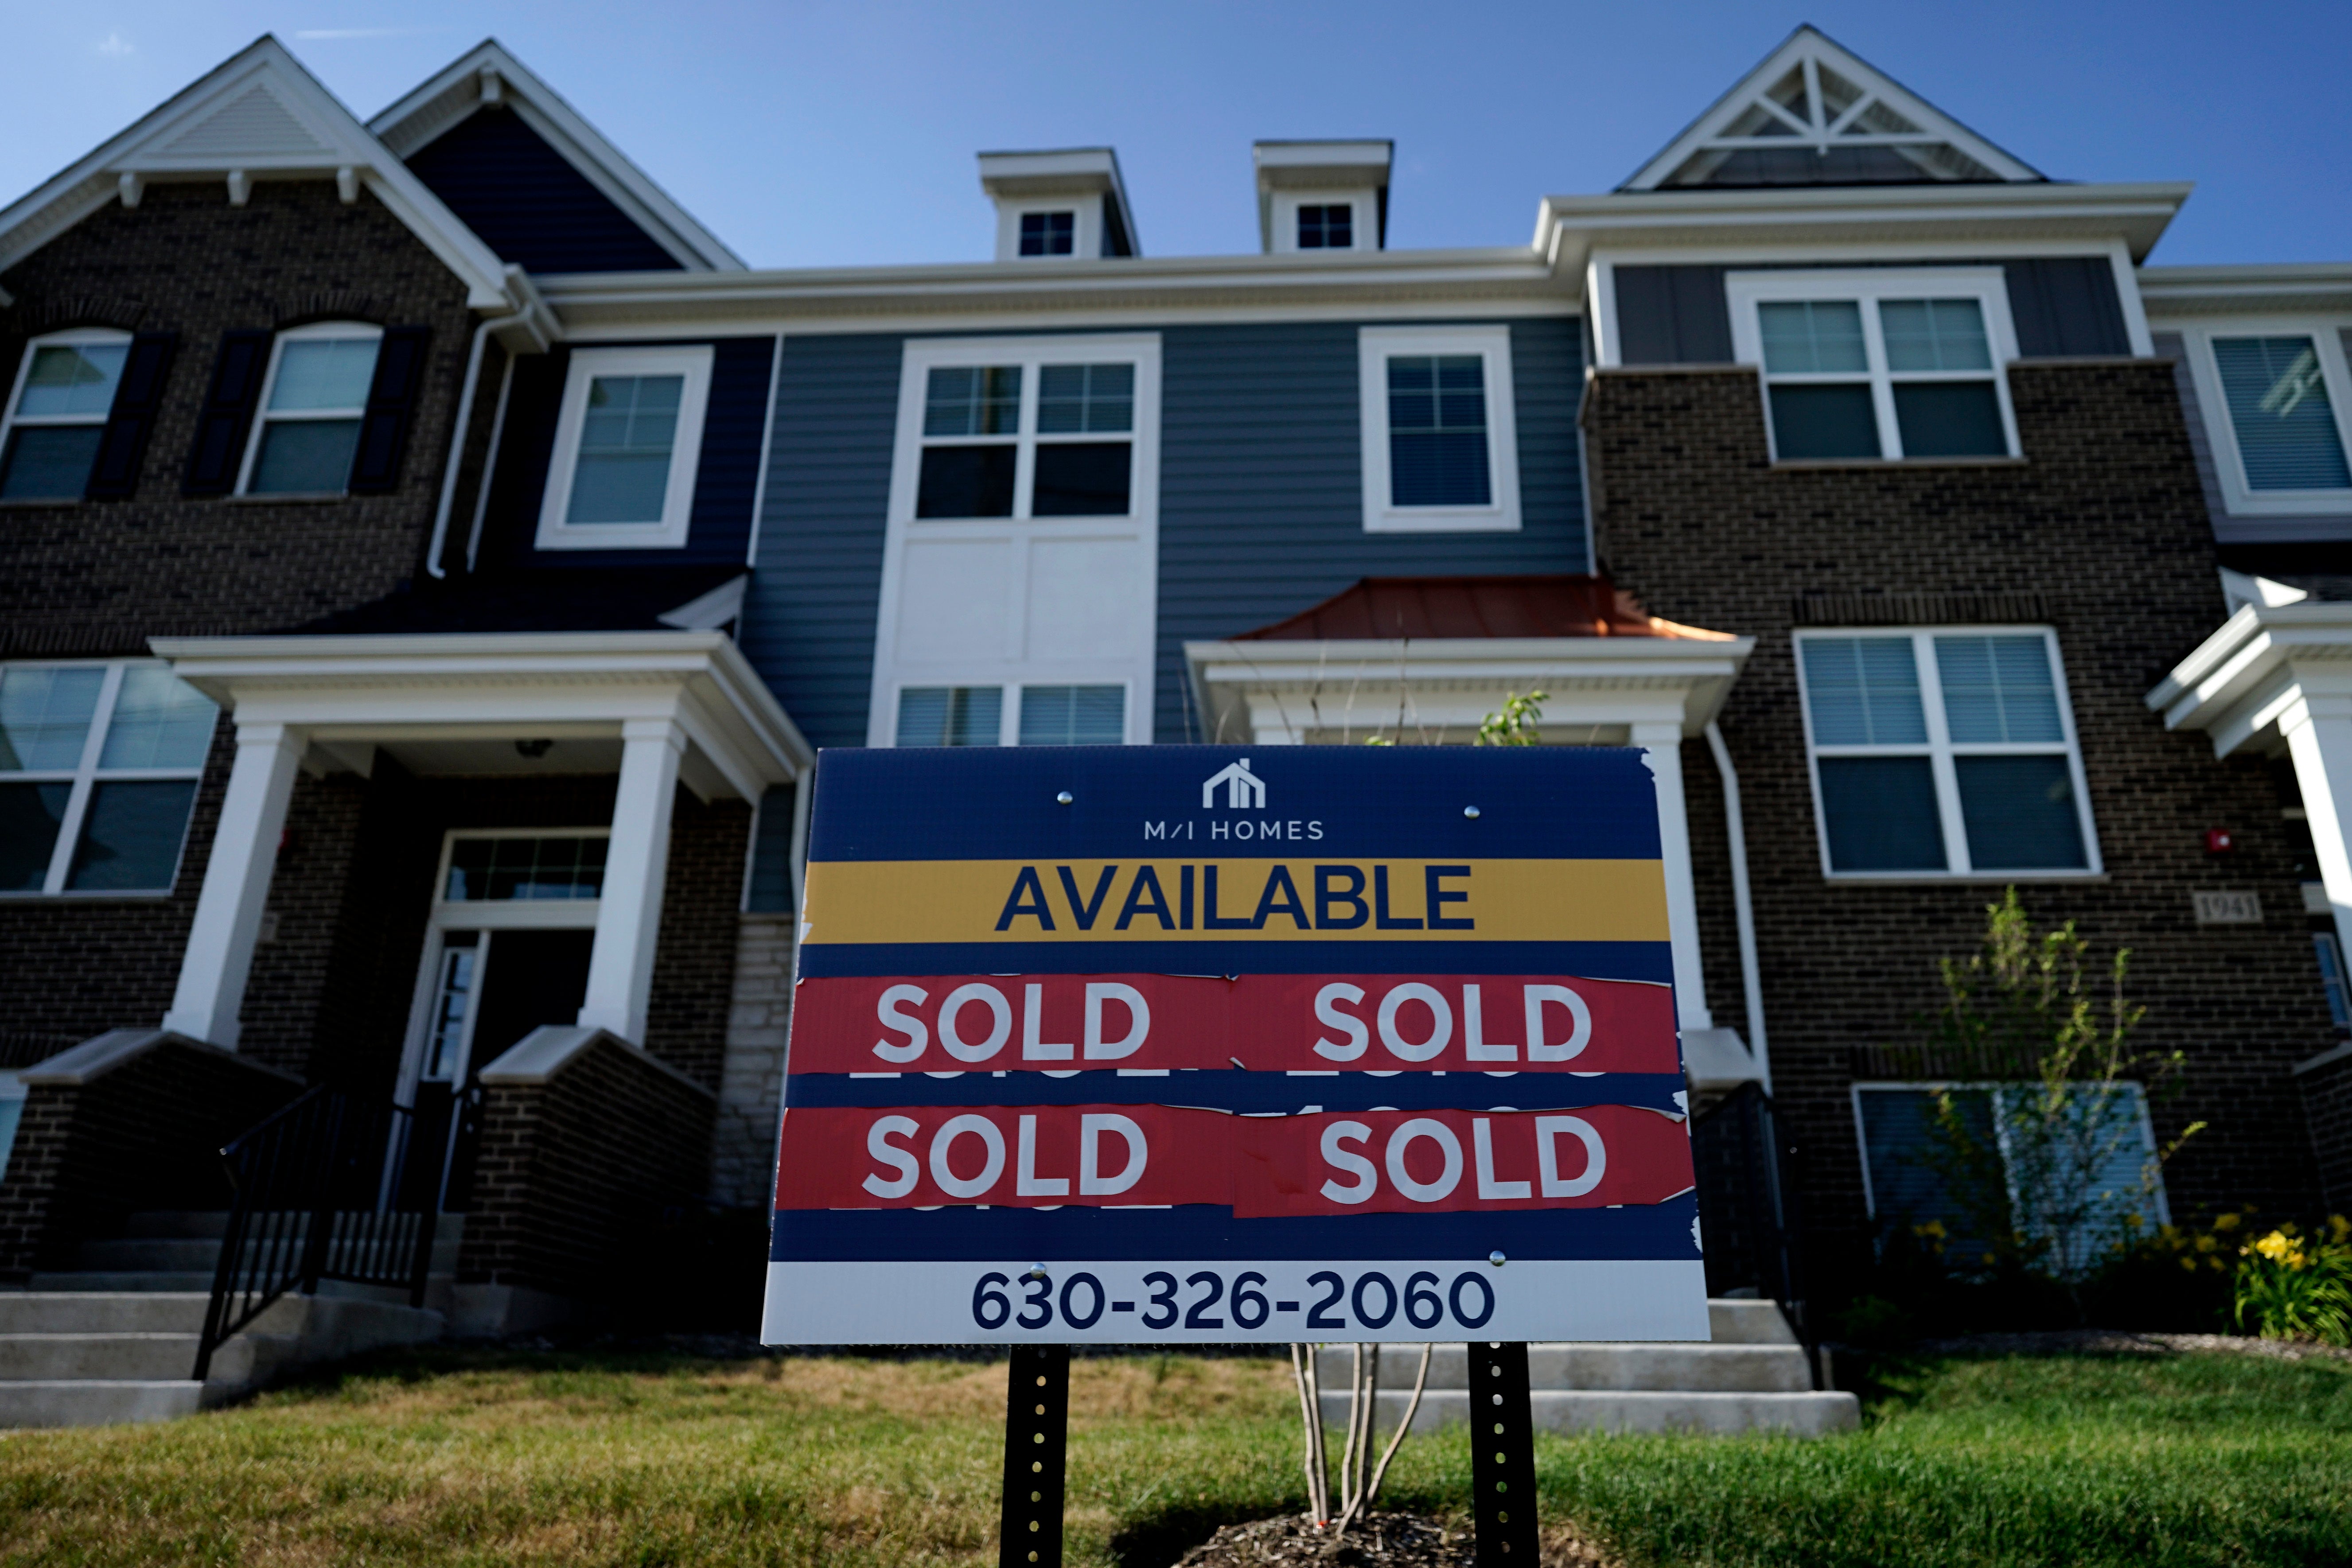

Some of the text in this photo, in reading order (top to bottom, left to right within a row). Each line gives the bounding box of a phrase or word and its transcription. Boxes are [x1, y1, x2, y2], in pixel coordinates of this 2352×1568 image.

[1145, 821, 1323, 840] M/I HOMES
[994, 864, 1475, 931] AVAILABLE
[2201, 895, 2256, 916] 1941
[872, 982, 1592, 1063] SOLD SOLD
[861, 1113, 1606, 1204] SOLD SOLD
[972, 1271, 1495, 1330] 630-326-2060
